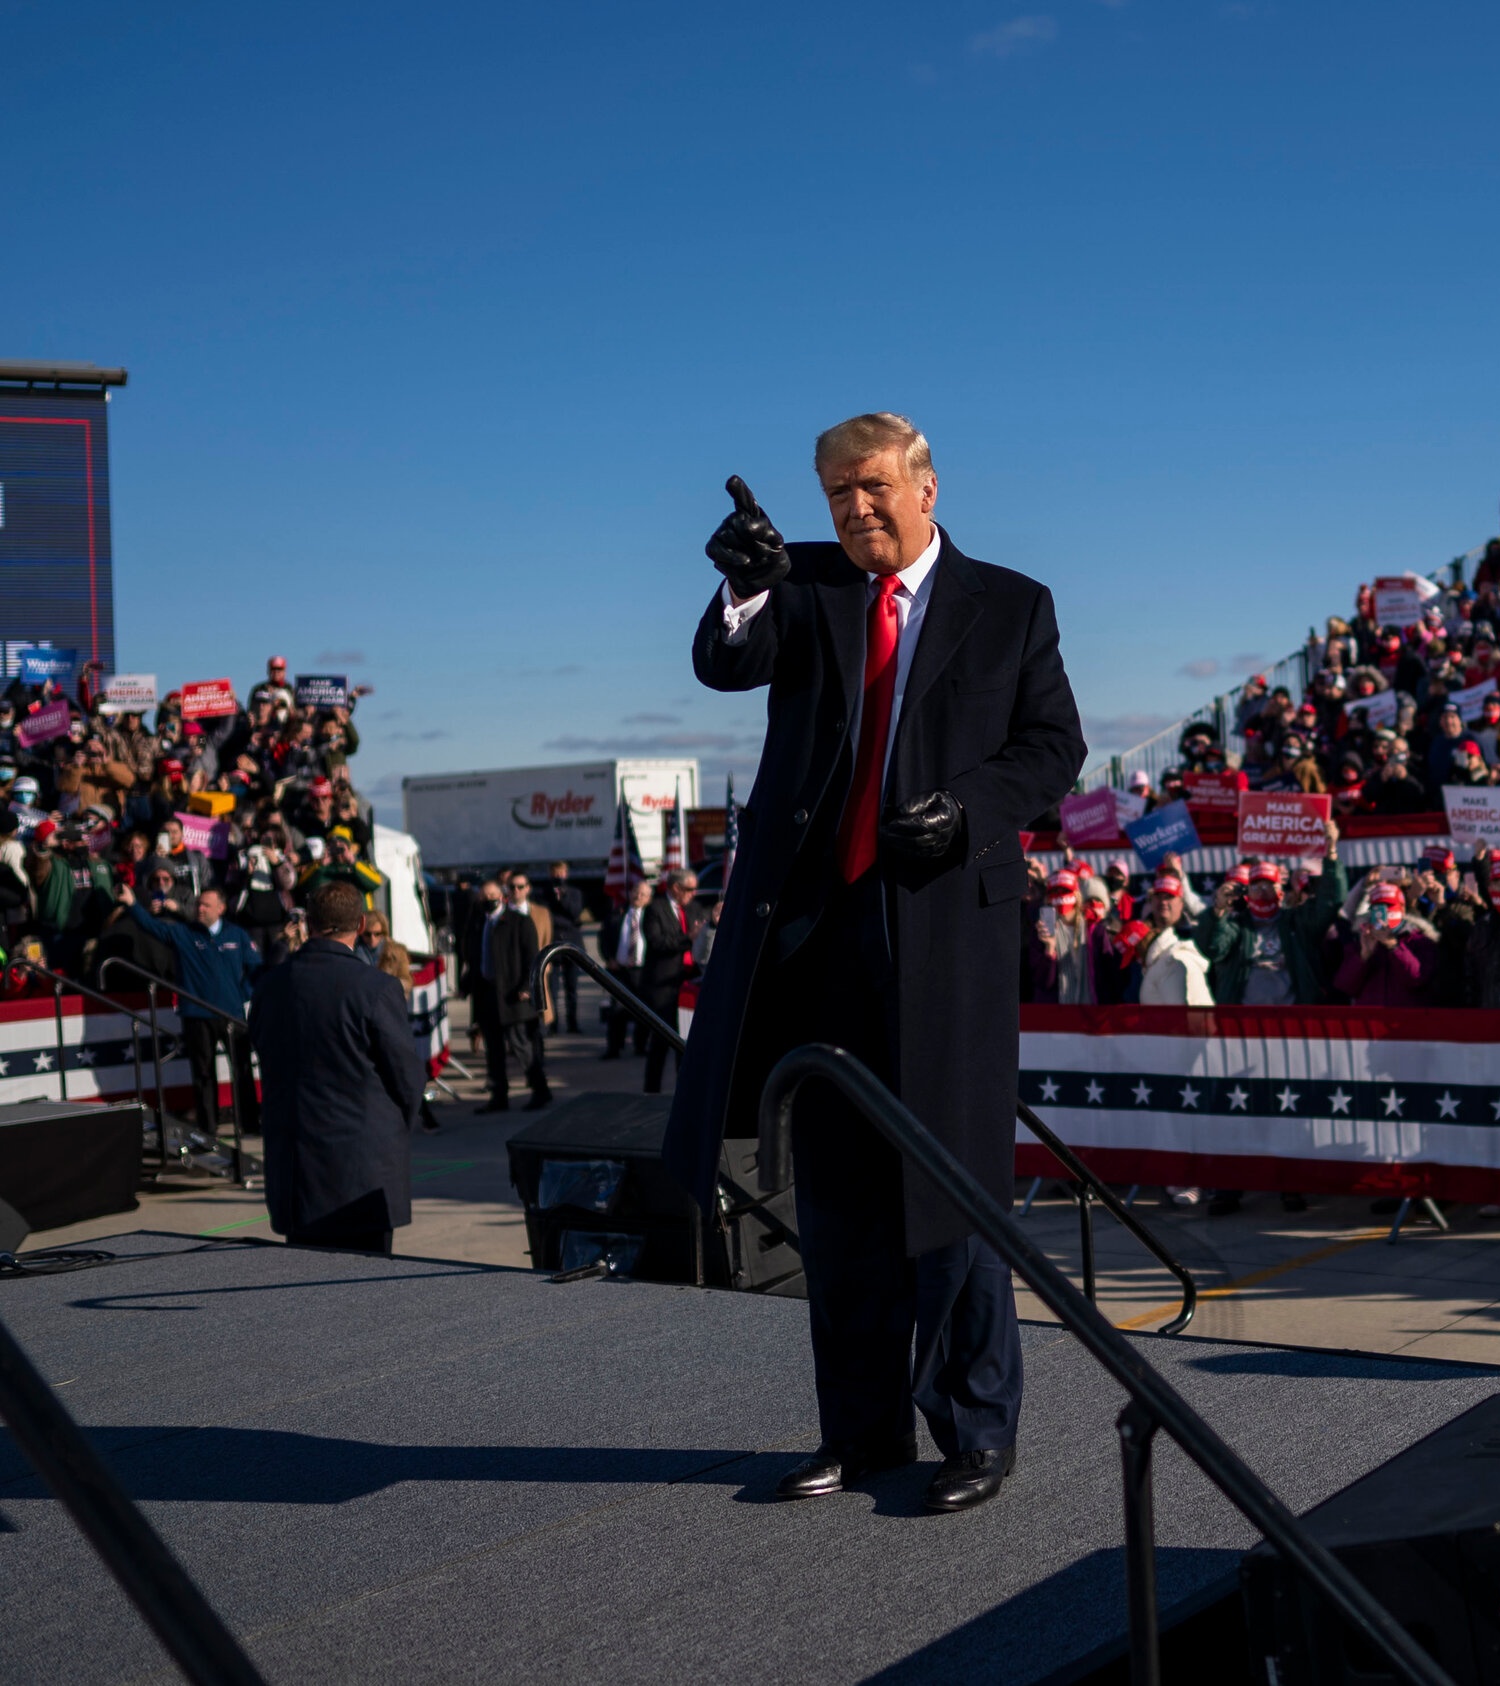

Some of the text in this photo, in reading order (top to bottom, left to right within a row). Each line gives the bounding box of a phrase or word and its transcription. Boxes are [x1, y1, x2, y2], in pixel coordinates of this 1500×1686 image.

[530, 790, 595, 820] Ryder
[641, 794, 676, 810] Ryde
[1266, 802, 1302, 814] MAKE
[1462, 797, 1489, 807] MAKE
[1064, 803, 1109, 828] Women
[1243, 814, 1326, 832] AMERICA
[1134, 820, 1187, 849] Workers
[1242, 831, 1327, 846] GREAT AGAIN
